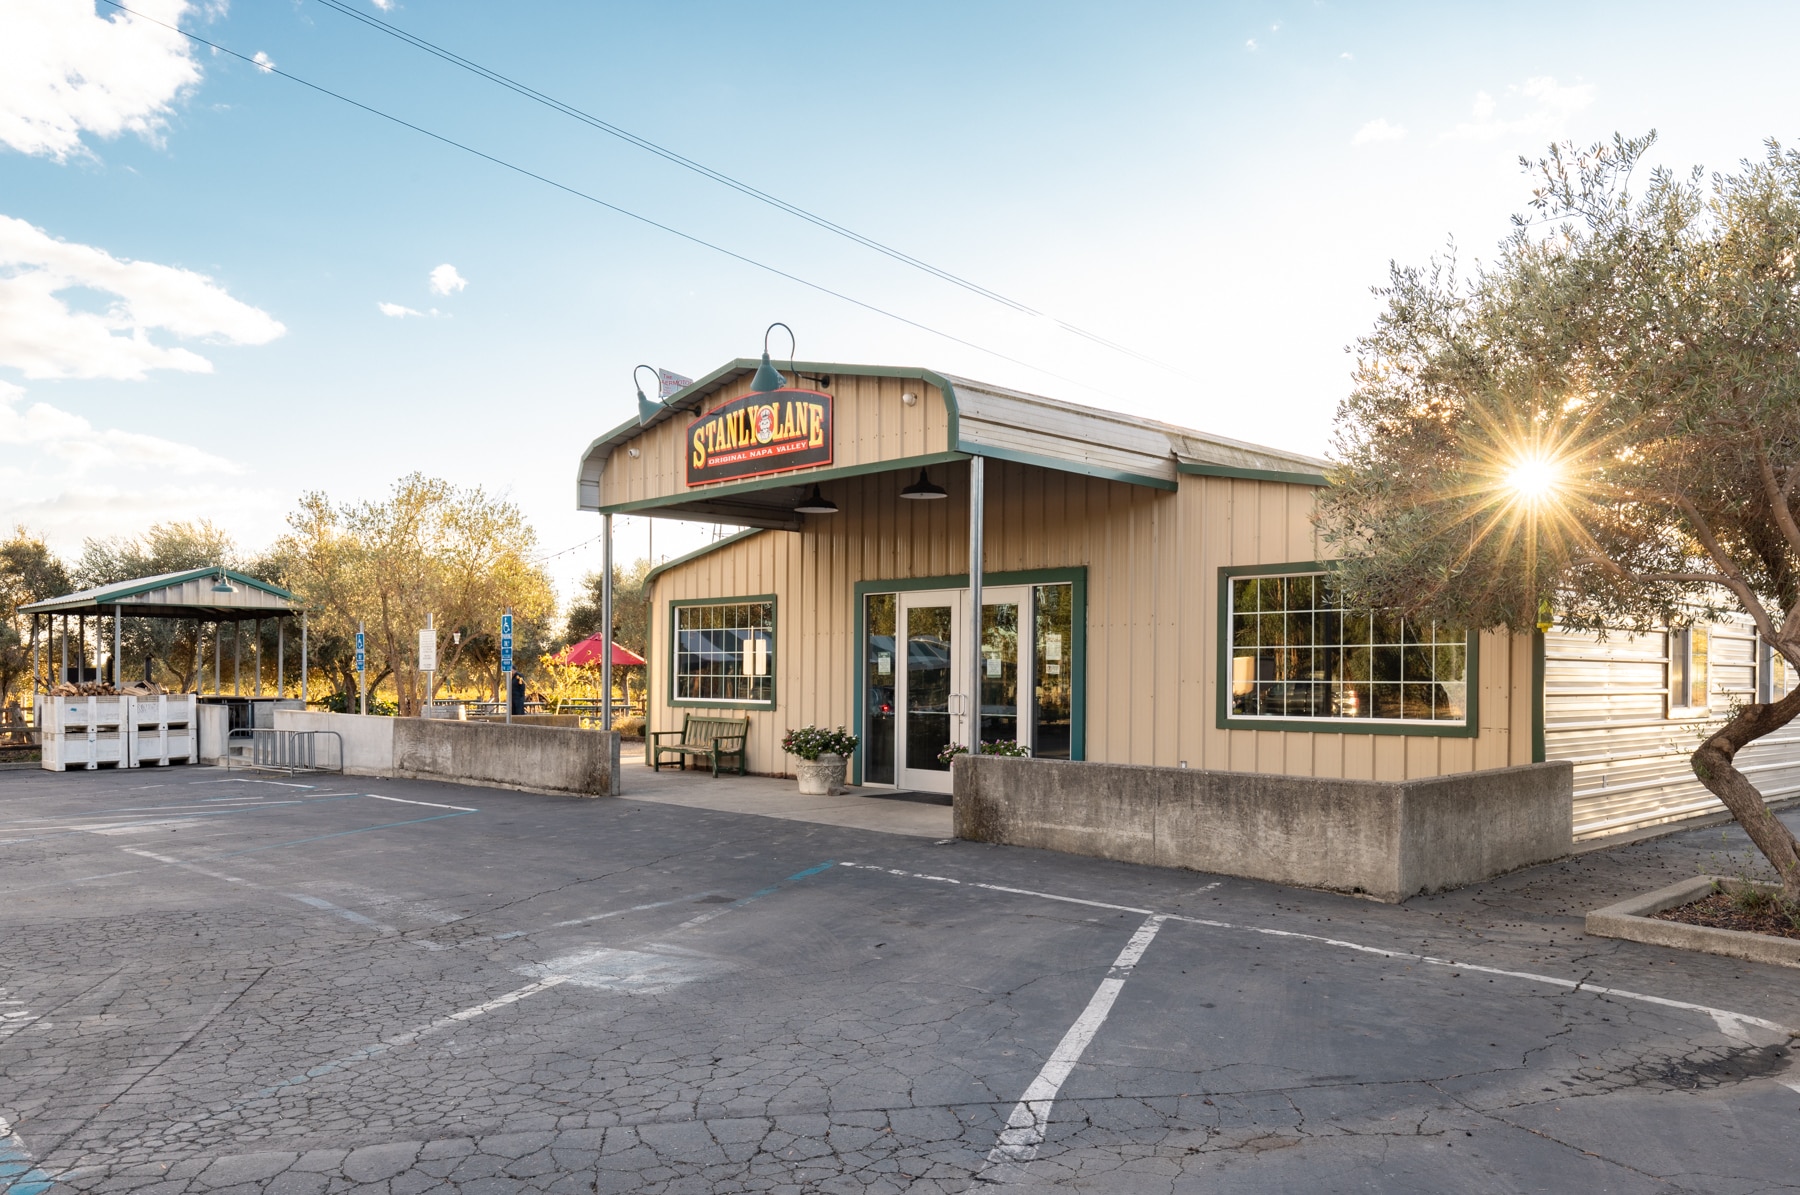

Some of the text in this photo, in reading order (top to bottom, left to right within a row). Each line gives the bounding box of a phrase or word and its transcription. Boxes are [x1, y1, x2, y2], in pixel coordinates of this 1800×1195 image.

[693, 401, 824, 469] STANLY LANE
[708, 442, 807, 465] ORIGINAL NAPA VALLEY
